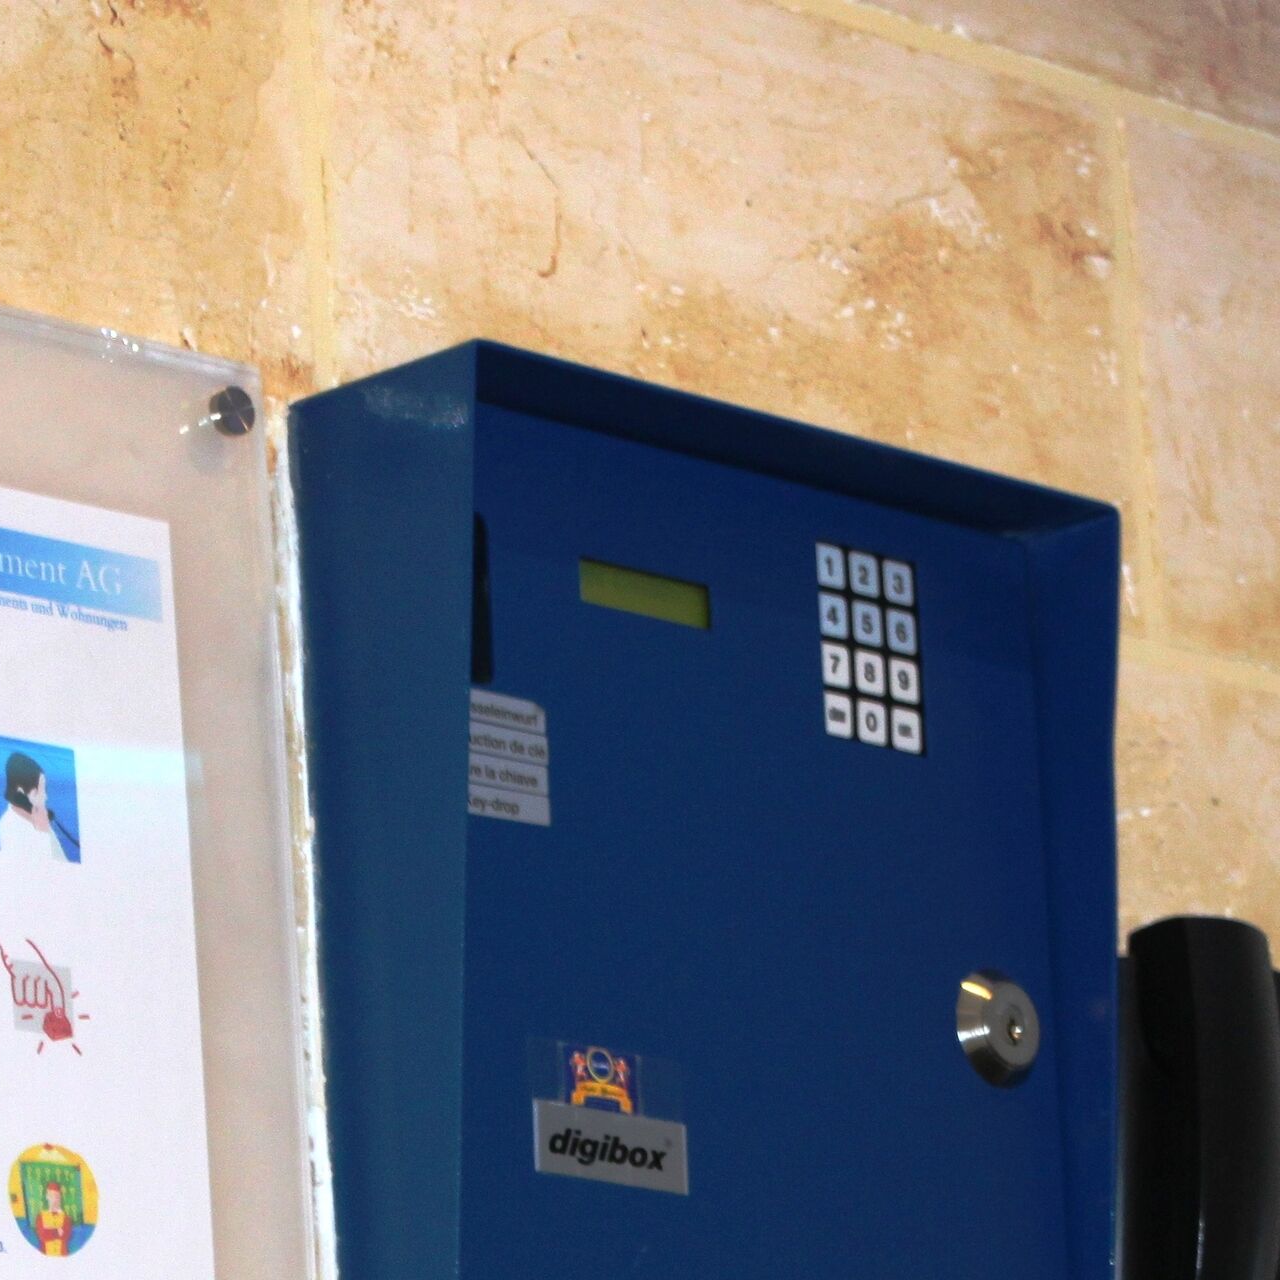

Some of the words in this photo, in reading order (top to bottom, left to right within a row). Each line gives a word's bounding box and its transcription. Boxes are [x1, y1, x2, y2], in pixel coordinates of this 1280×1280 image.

[76, 560, 121, 595] AG
[826, 556, 833, 577] 1
[859, 564, 868, 586] 2
[893, 573, 904, 594] 3
[826, 606, 838, 626] 4
[862, 612, 873, 634] 5
[896, 621, 907, 643] 6
[830, 654, 840, 674] 7
[864, 662, 875, 683] 8
[898, 670, 909, 691] 9
[865, 710, 877, 733] 0
[548, 1128, 667, 1171] digibox
